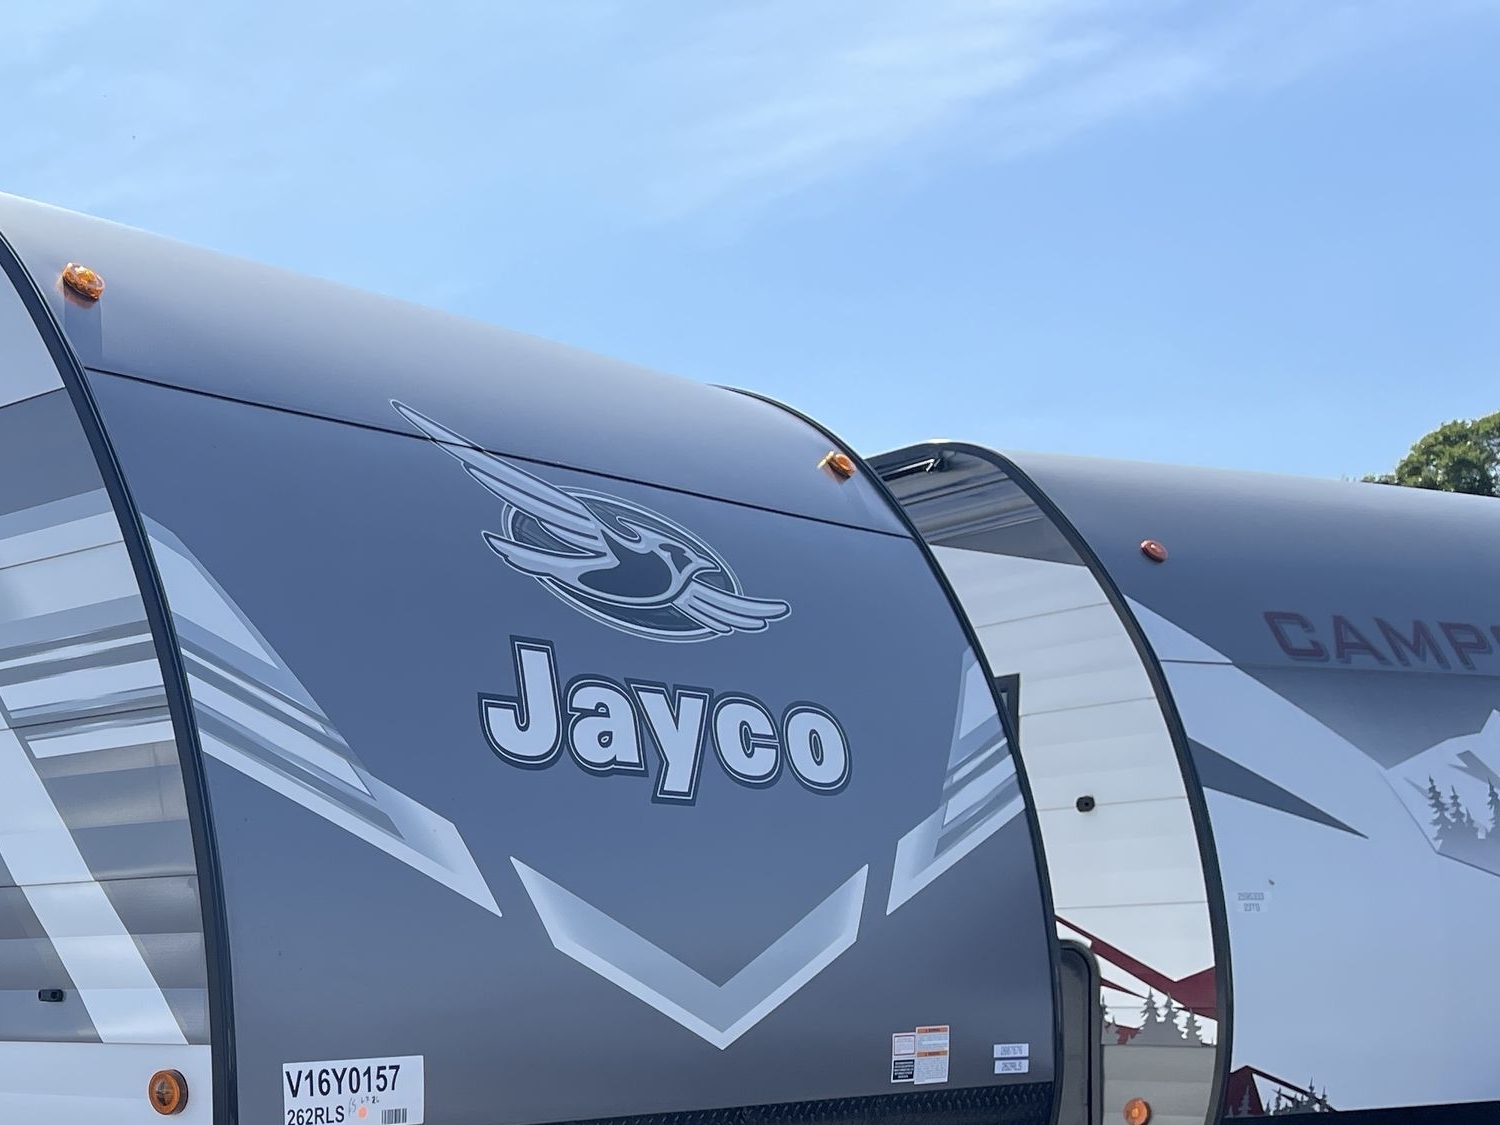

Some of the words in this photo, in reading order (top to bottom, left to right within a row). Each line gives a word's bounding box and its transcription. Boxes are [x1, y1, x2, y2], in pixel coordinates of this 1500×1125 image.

[1263, 610, 1500, 671] CAMP
[479, 637, 851, 804] Jayco
[285, 1064, 401, 1098] V16Y0157
